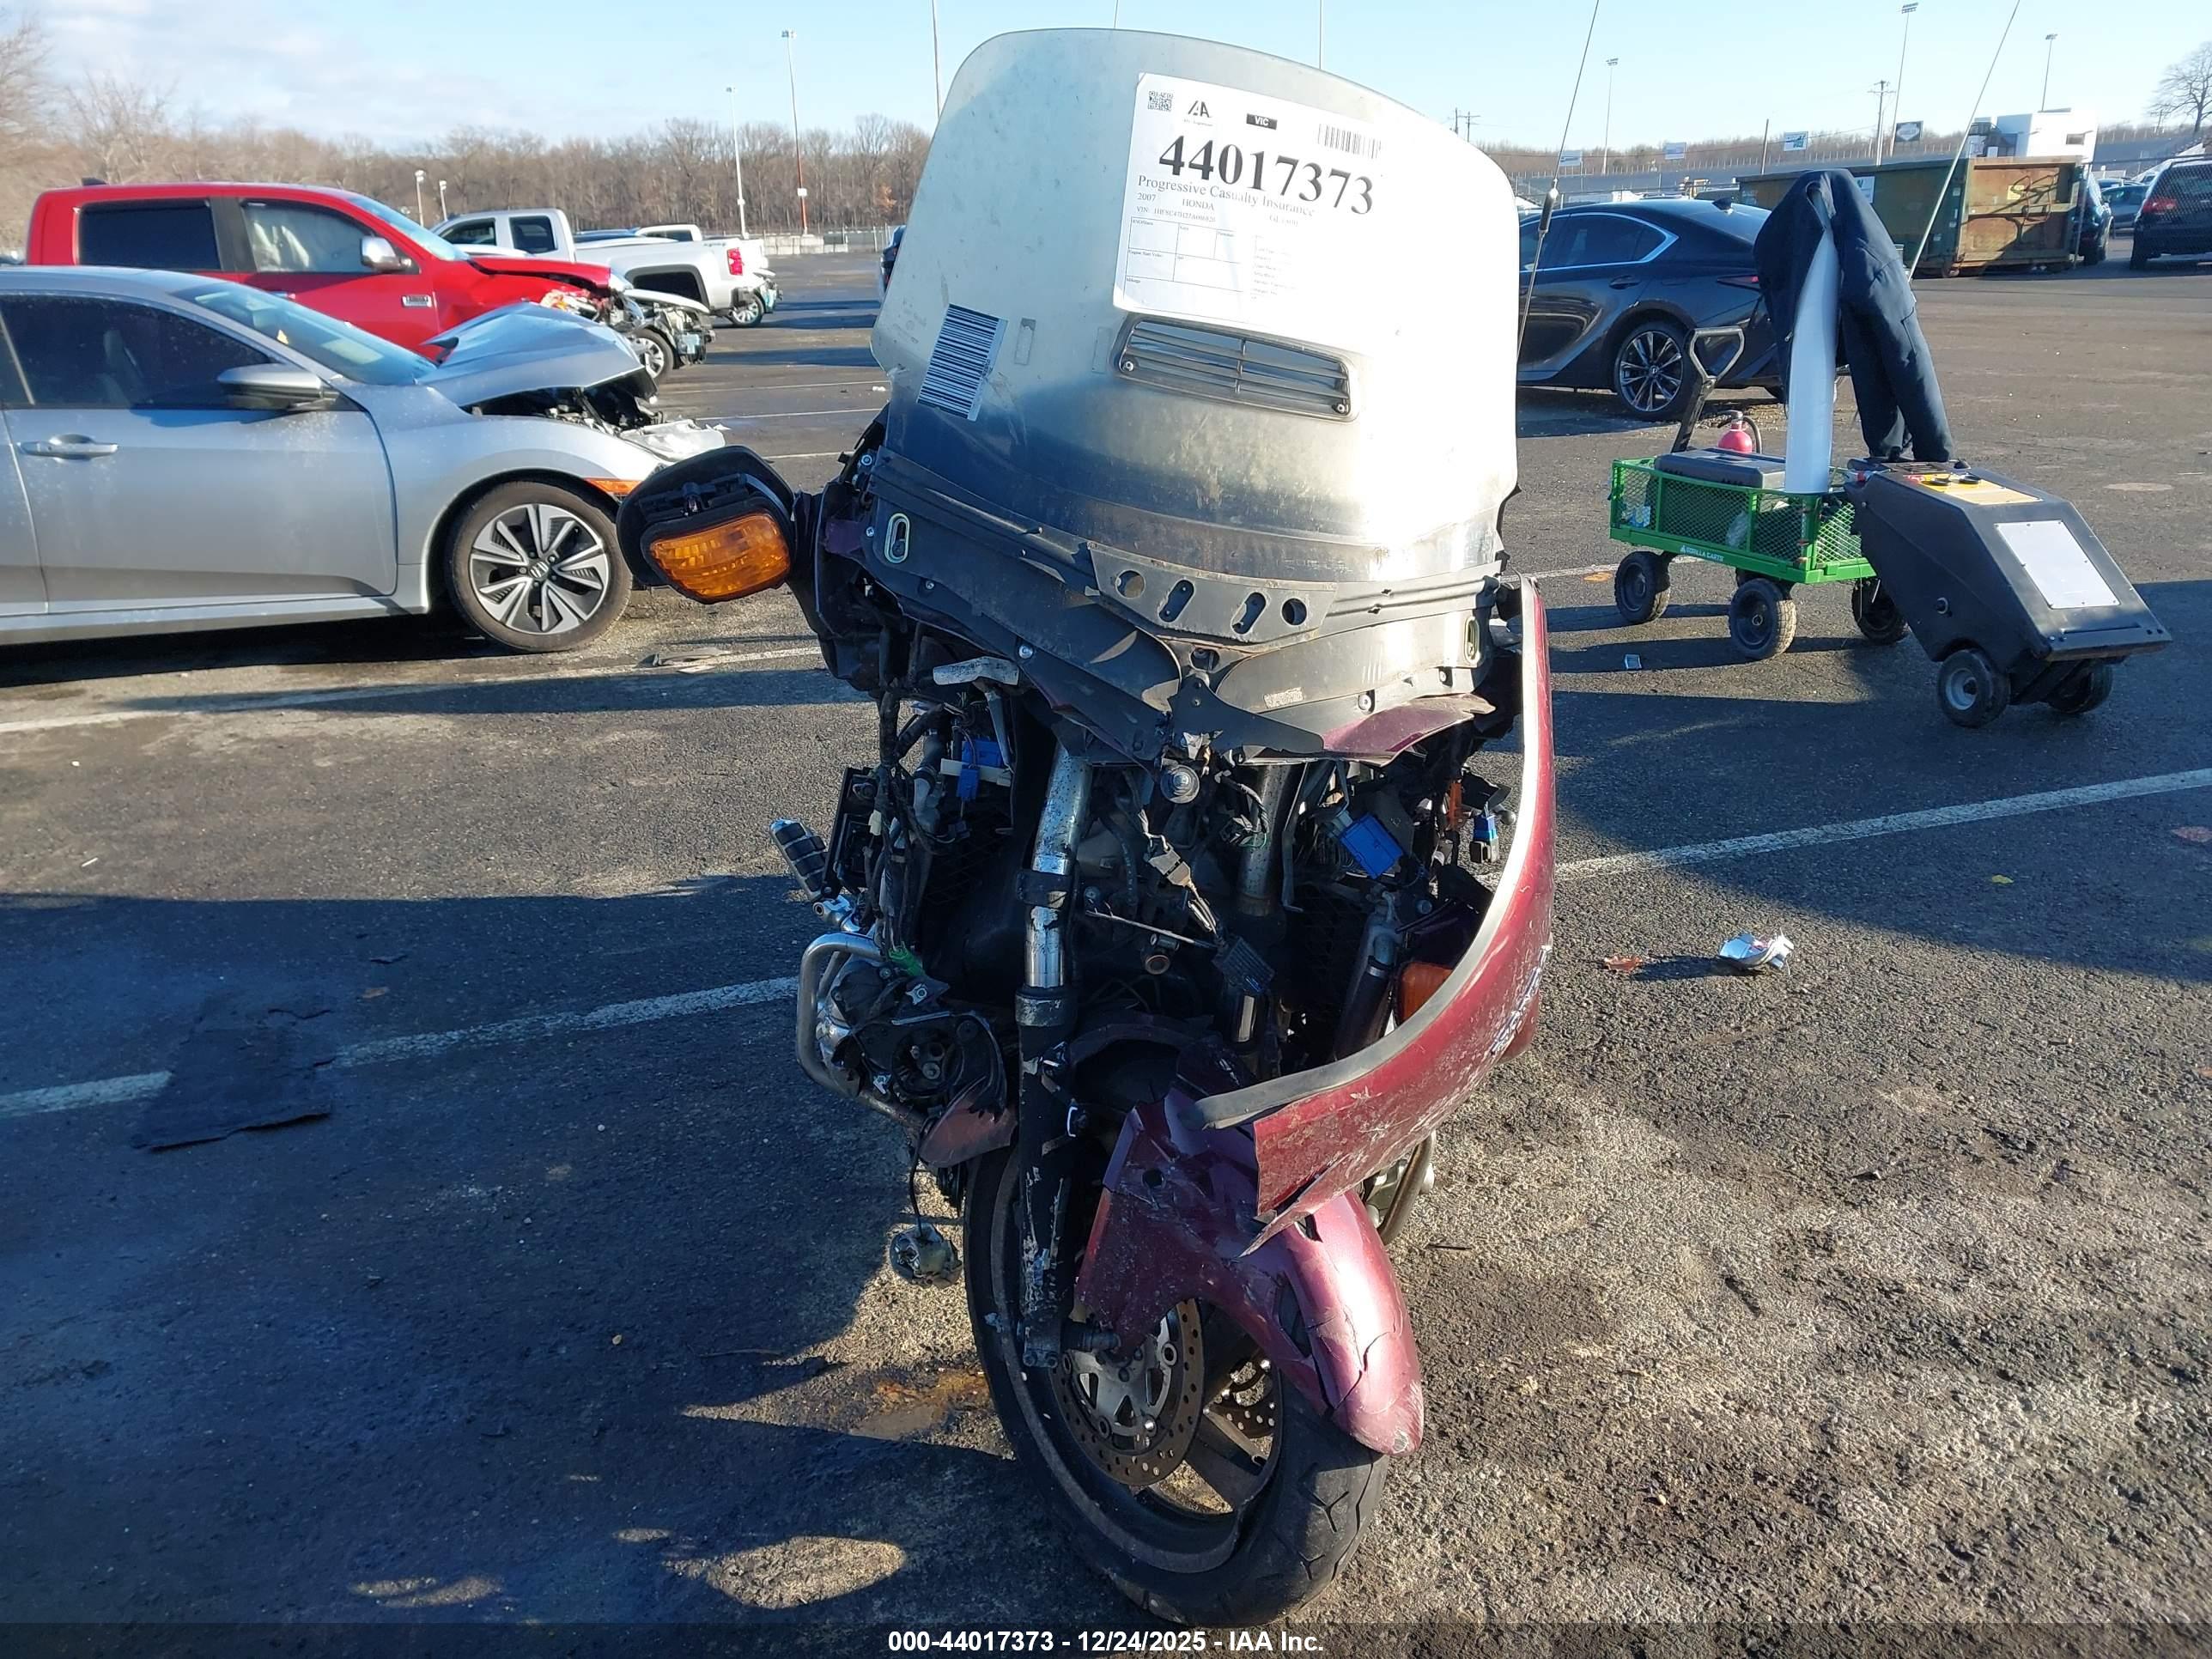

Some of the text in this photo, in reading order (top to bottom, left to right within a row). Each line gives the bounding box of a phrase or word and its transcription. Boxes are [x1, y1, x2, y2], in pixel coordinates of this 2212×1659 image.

[1255, 116, 1269, 126] VIC
[1158, 135, 1373, 215] 44017373
[1137, 192, 1156, 202] 2007
[1138, 175, 1316, 216] Progressive Casualty Insurance
[1182, 198, 1215, 211] HONDA
